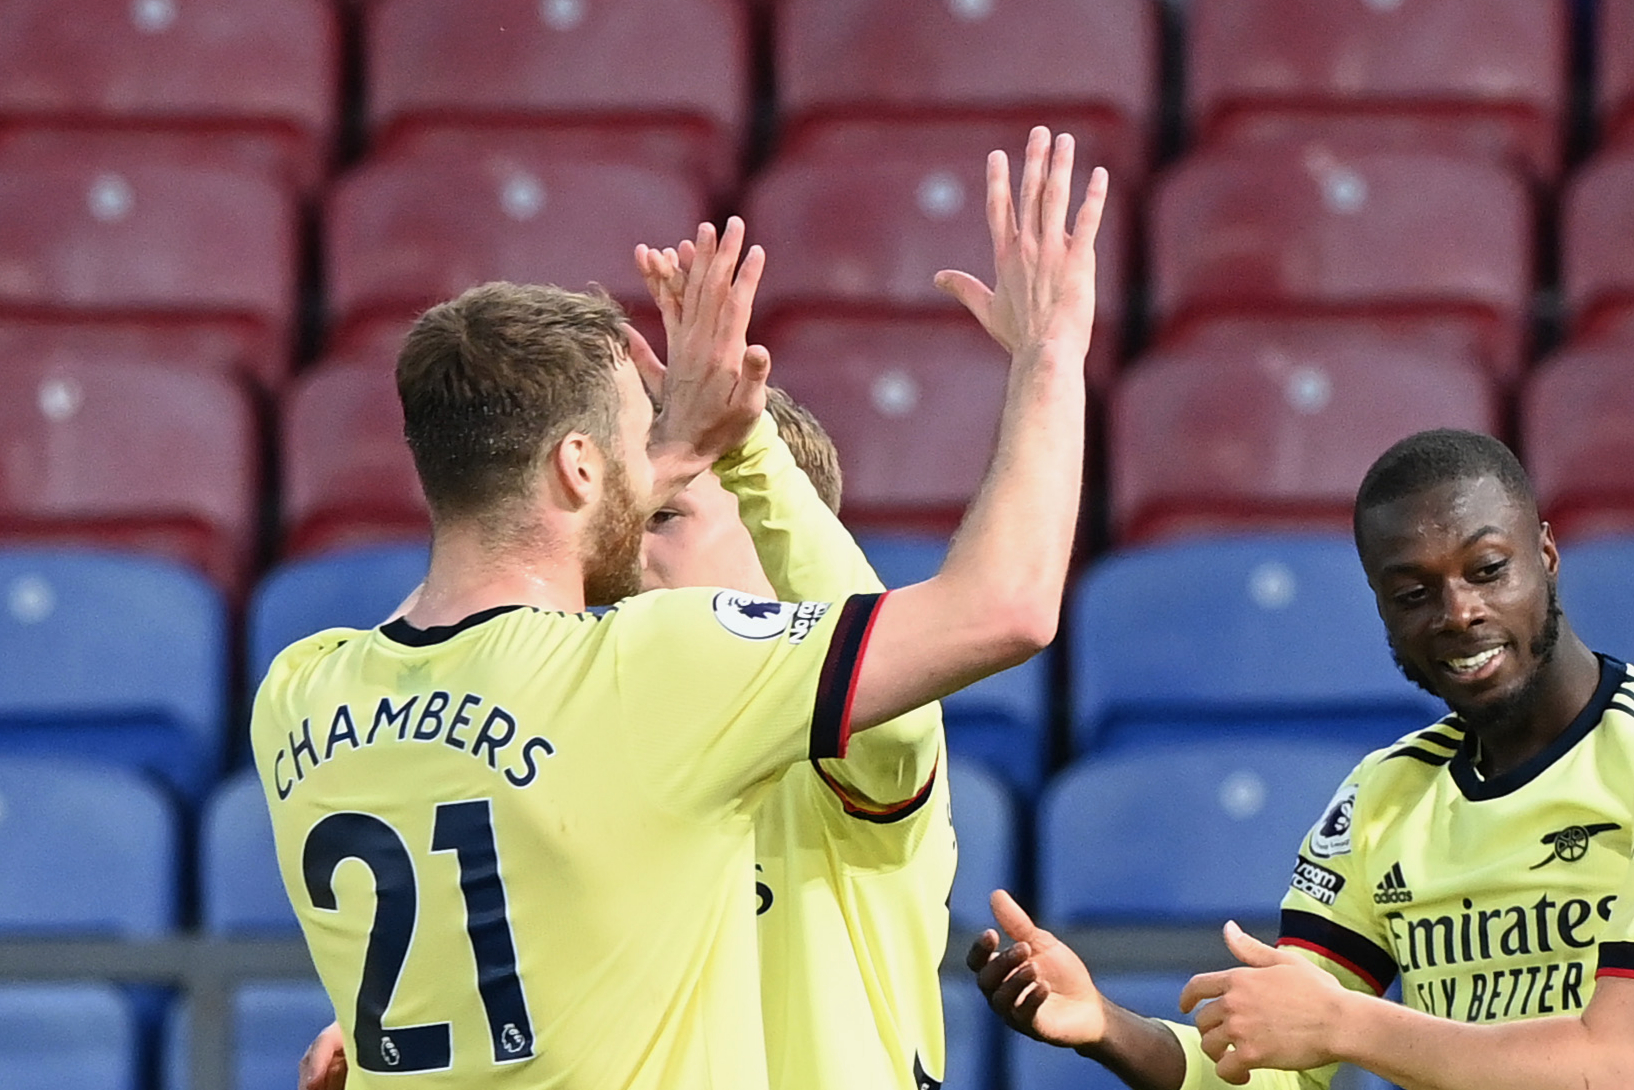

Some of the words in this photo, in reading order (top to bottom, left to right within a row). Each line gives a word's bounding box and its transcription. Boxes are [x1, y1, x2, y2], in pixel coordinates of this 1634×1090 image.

[273, 690, 555, 802] CHAMBERS
[301, 797, 536, 1074] 21
[1466, 961, 1584, 1022] BETTER
